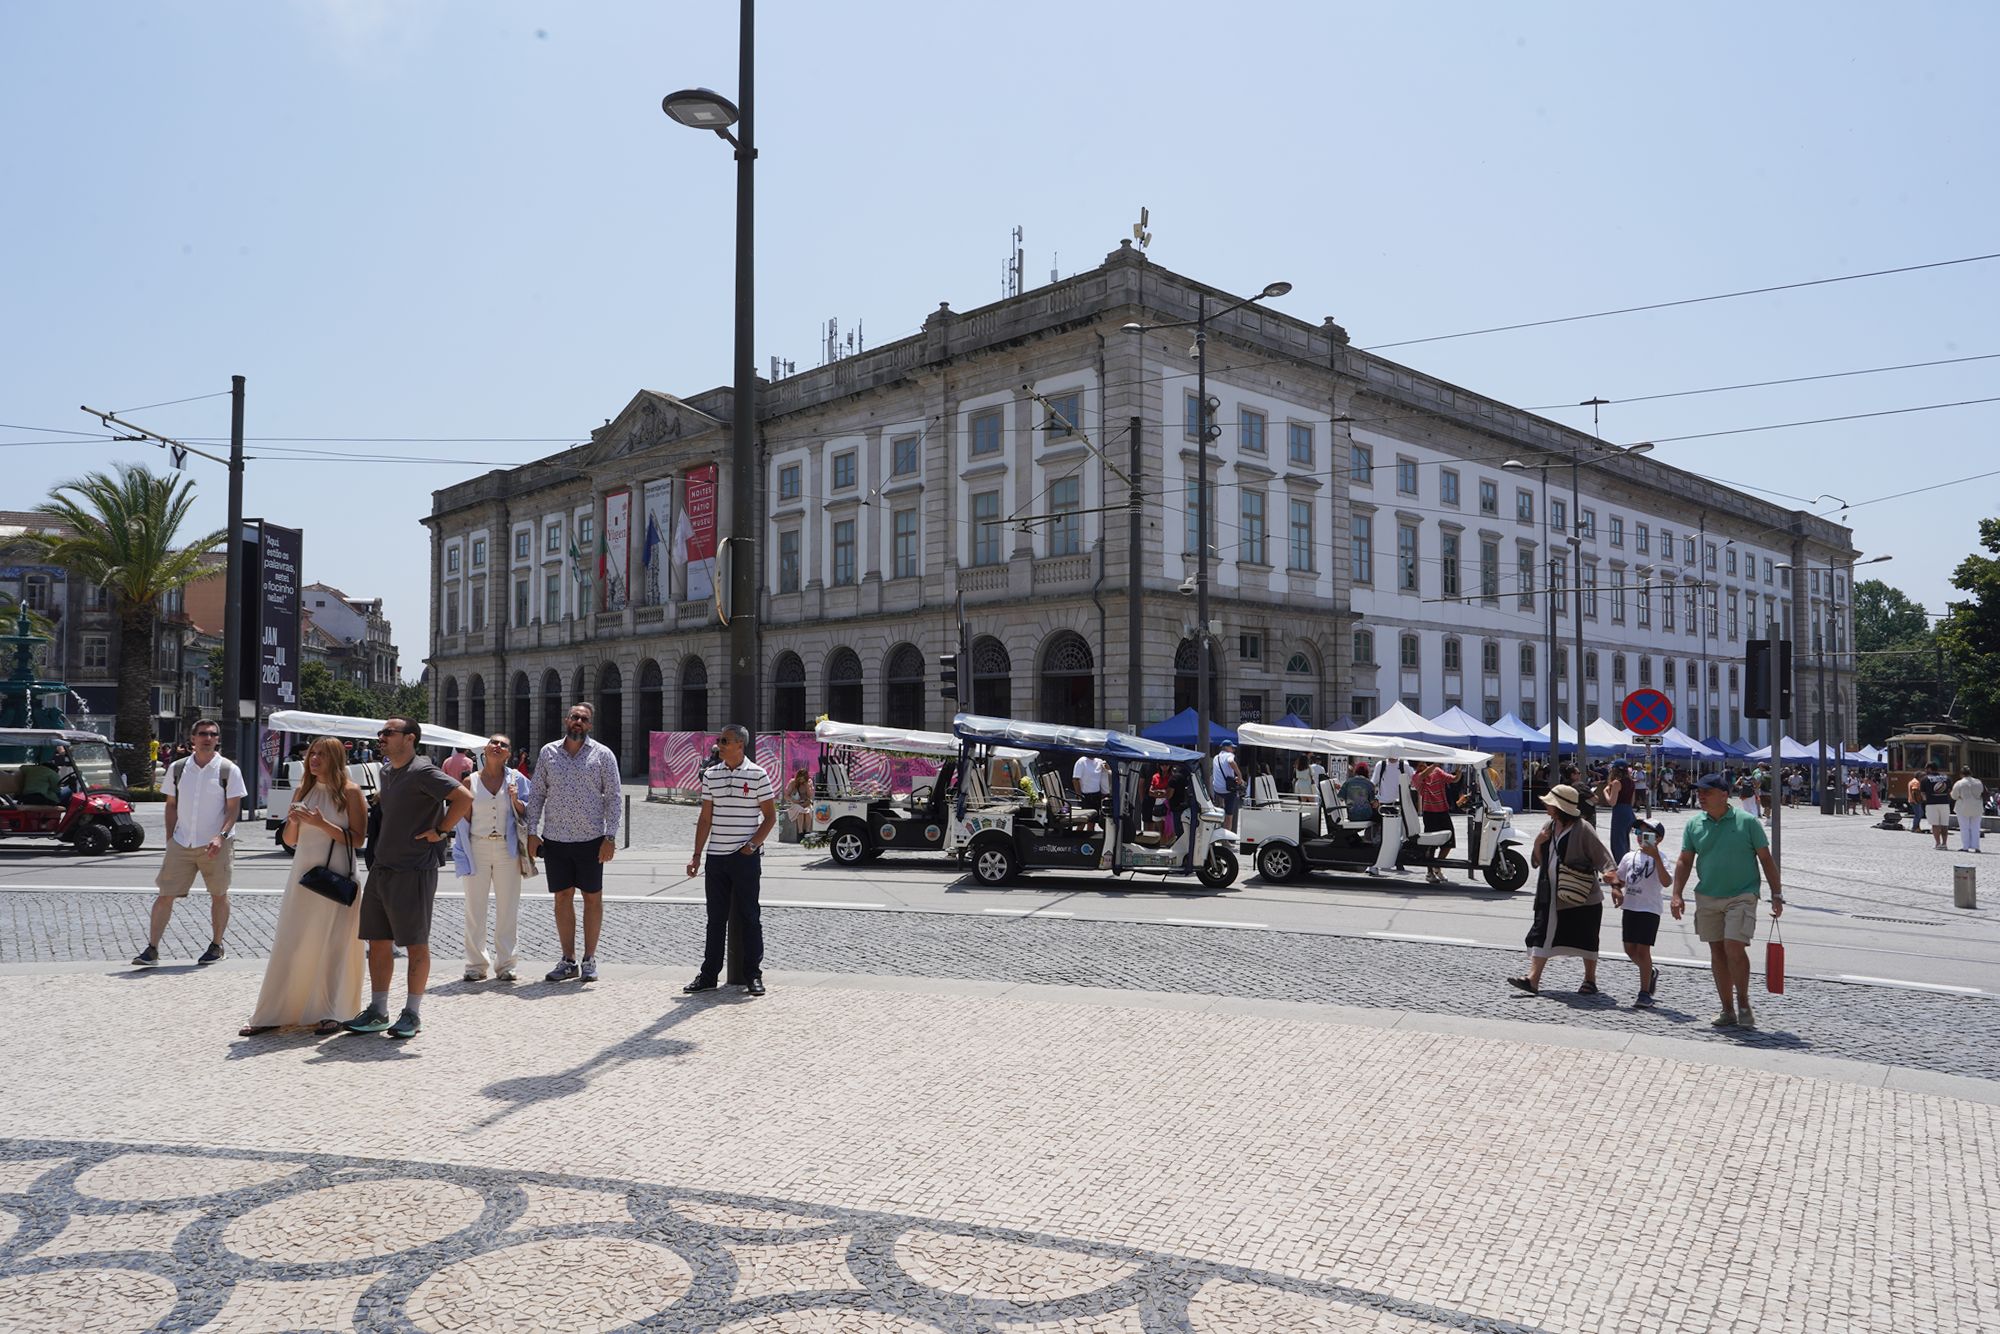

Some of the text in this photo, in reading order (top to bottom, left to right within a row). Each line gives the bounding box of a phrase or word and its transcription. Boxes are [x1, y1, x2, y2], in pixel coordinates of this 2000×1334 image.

[691, 487, 712, 498] NOITES
[693, 502, 710, 513] PÁTIO
[692, 517, 711, 527] MUSEU
[264, 559, 295, 575] palavras,
[263, 580, 294, 595] o focinho
[262, 626, 278, 646] JAN
[262, 664, 280, 684] 2026
